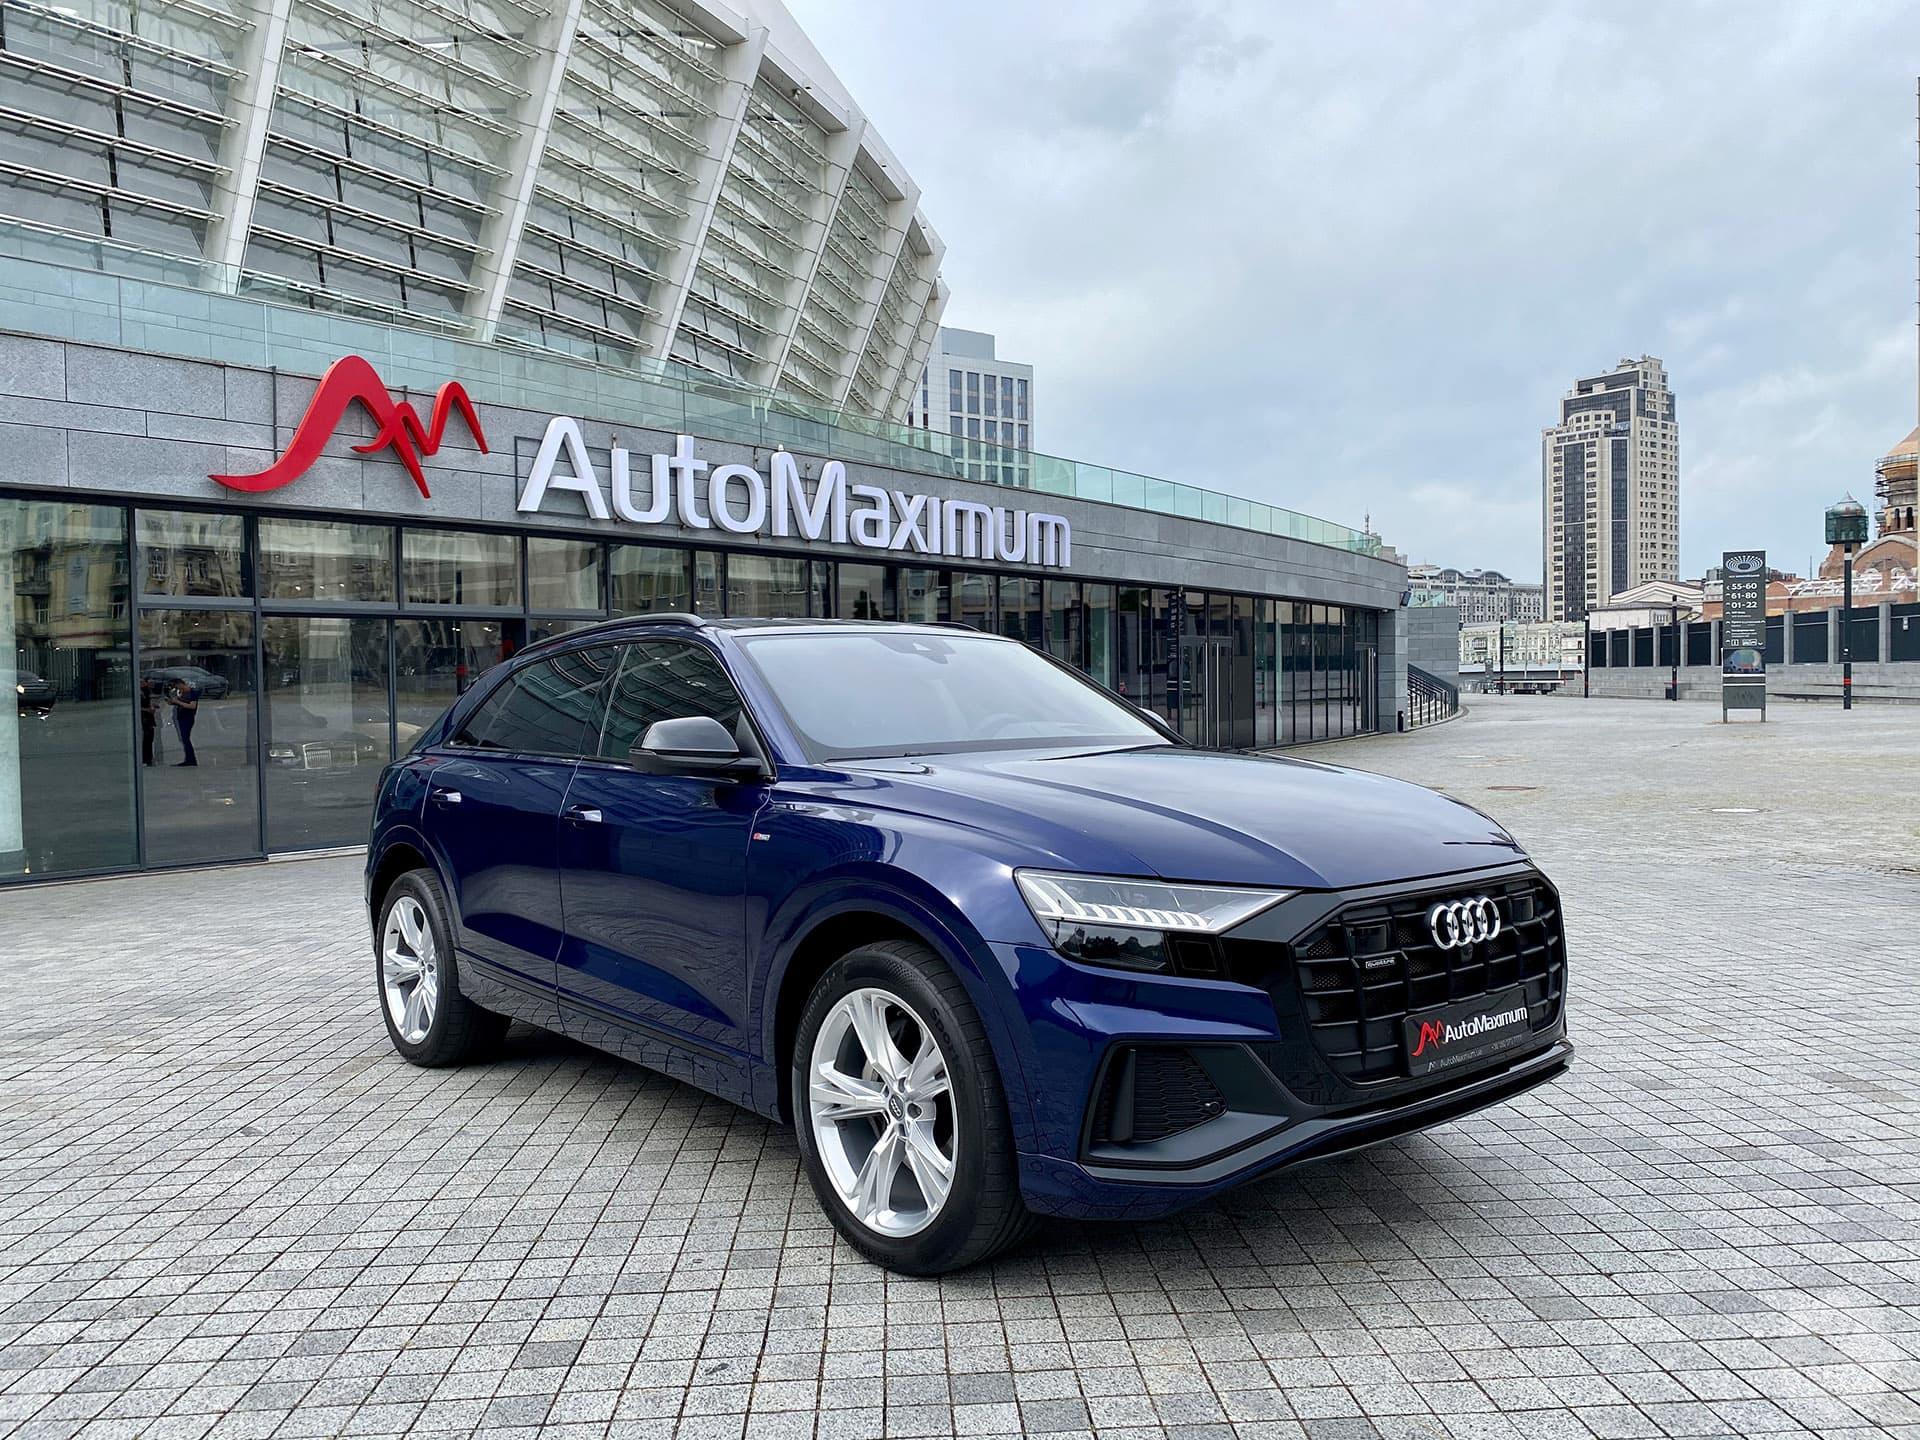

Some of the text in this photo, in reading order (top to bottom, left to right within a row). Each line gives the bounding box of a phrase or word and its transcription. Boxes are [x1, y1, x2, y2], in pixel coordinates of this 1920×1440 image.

[517, 416, 1071, 567] AutoMaximum
[1731, 601, 1757, 609] 01-22
[1444, 1006, 1528, 1043] AutoMaximum
